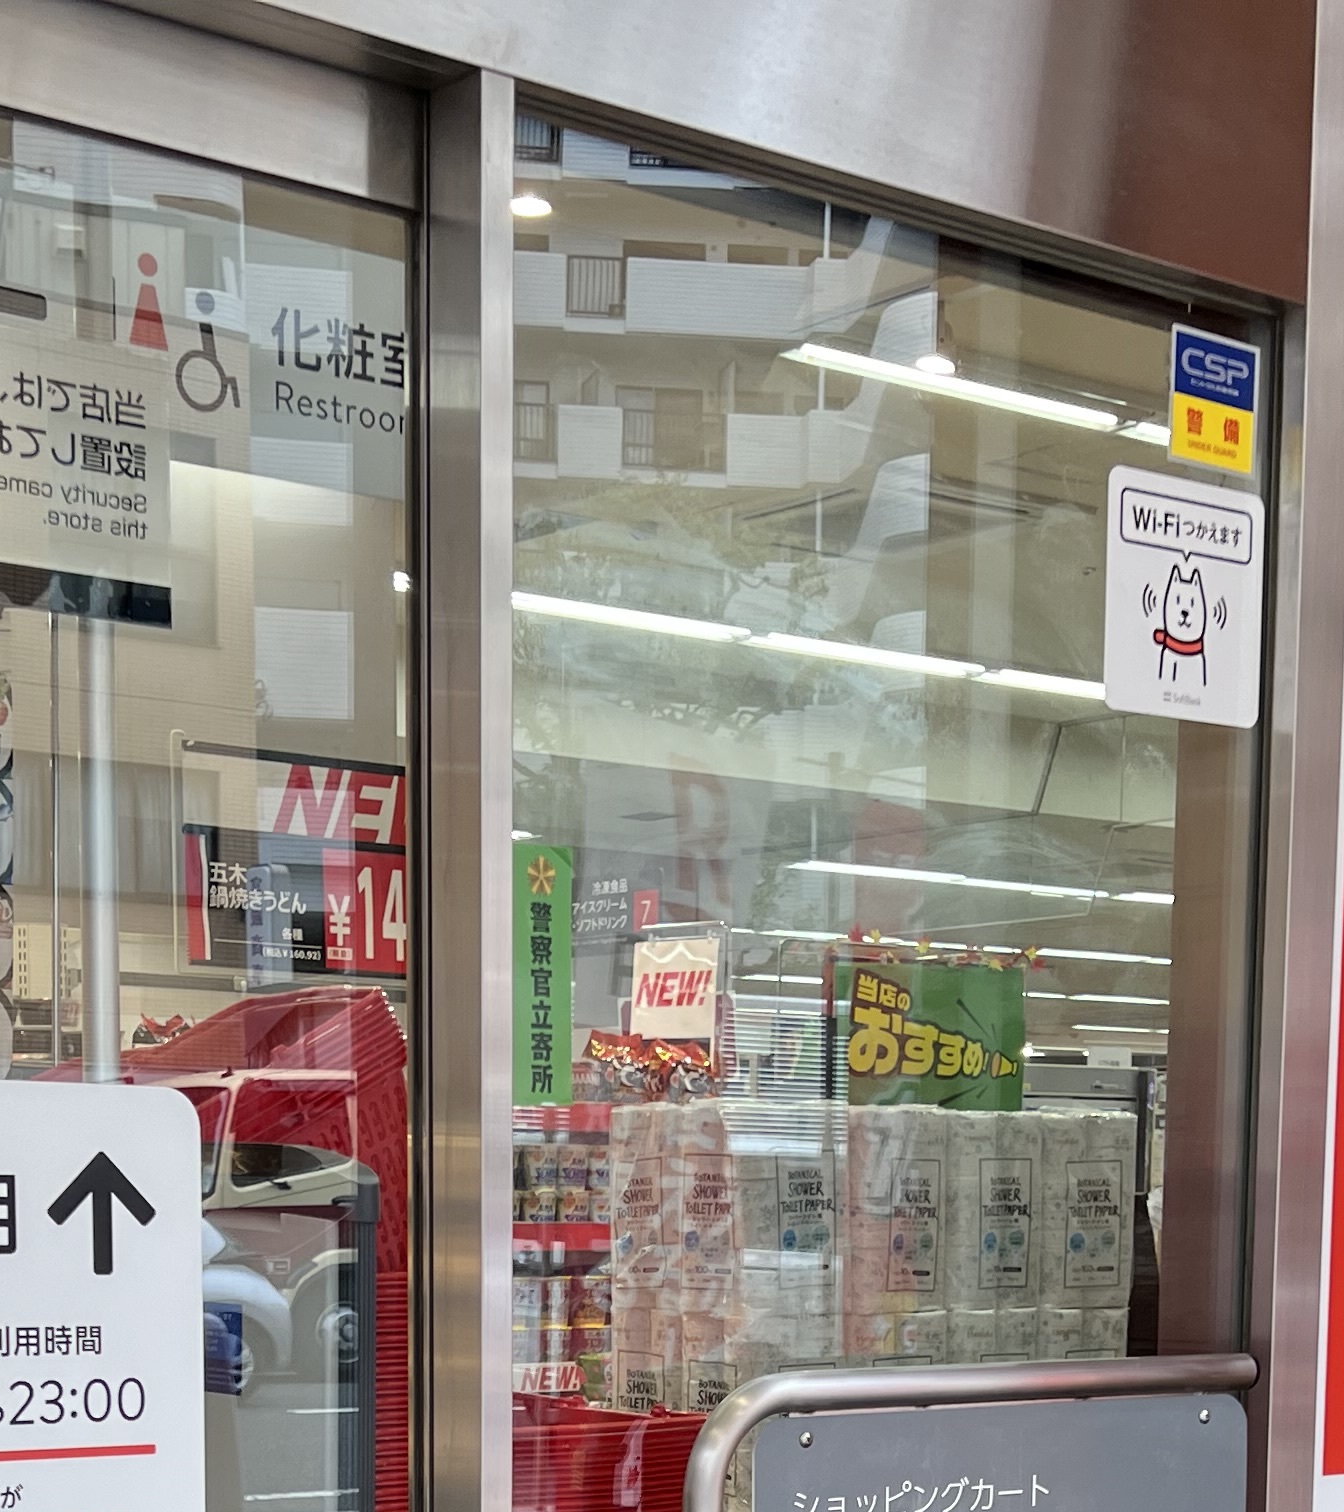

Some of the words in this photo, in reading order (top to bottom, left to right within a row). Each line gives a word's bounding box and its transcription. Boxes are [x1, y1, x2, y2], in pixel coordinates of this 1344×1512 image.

[1181, 346, 1250, 386] CSP
[275, 380, 405, 436] Restroo
[1186, 405, 1240, 445] 警備
[208, 861, 248, 886] 五木
[208, 884, 307, 915] 鍋焼きうどん
[571, 898, 628, 915] アイスクリーム
[640, 899, 651, 923] 7
[327, 893, 351, 947] ¥
[529, 901, 553, 1095] 警察官立寄所
[634, 969, 714, 1009] NEW!
[856, 973, 911, 1012] 当店の
[1076, 1188, 1112, 1205] SHOWER
[520, 1365, 581, 1392] NEW!
